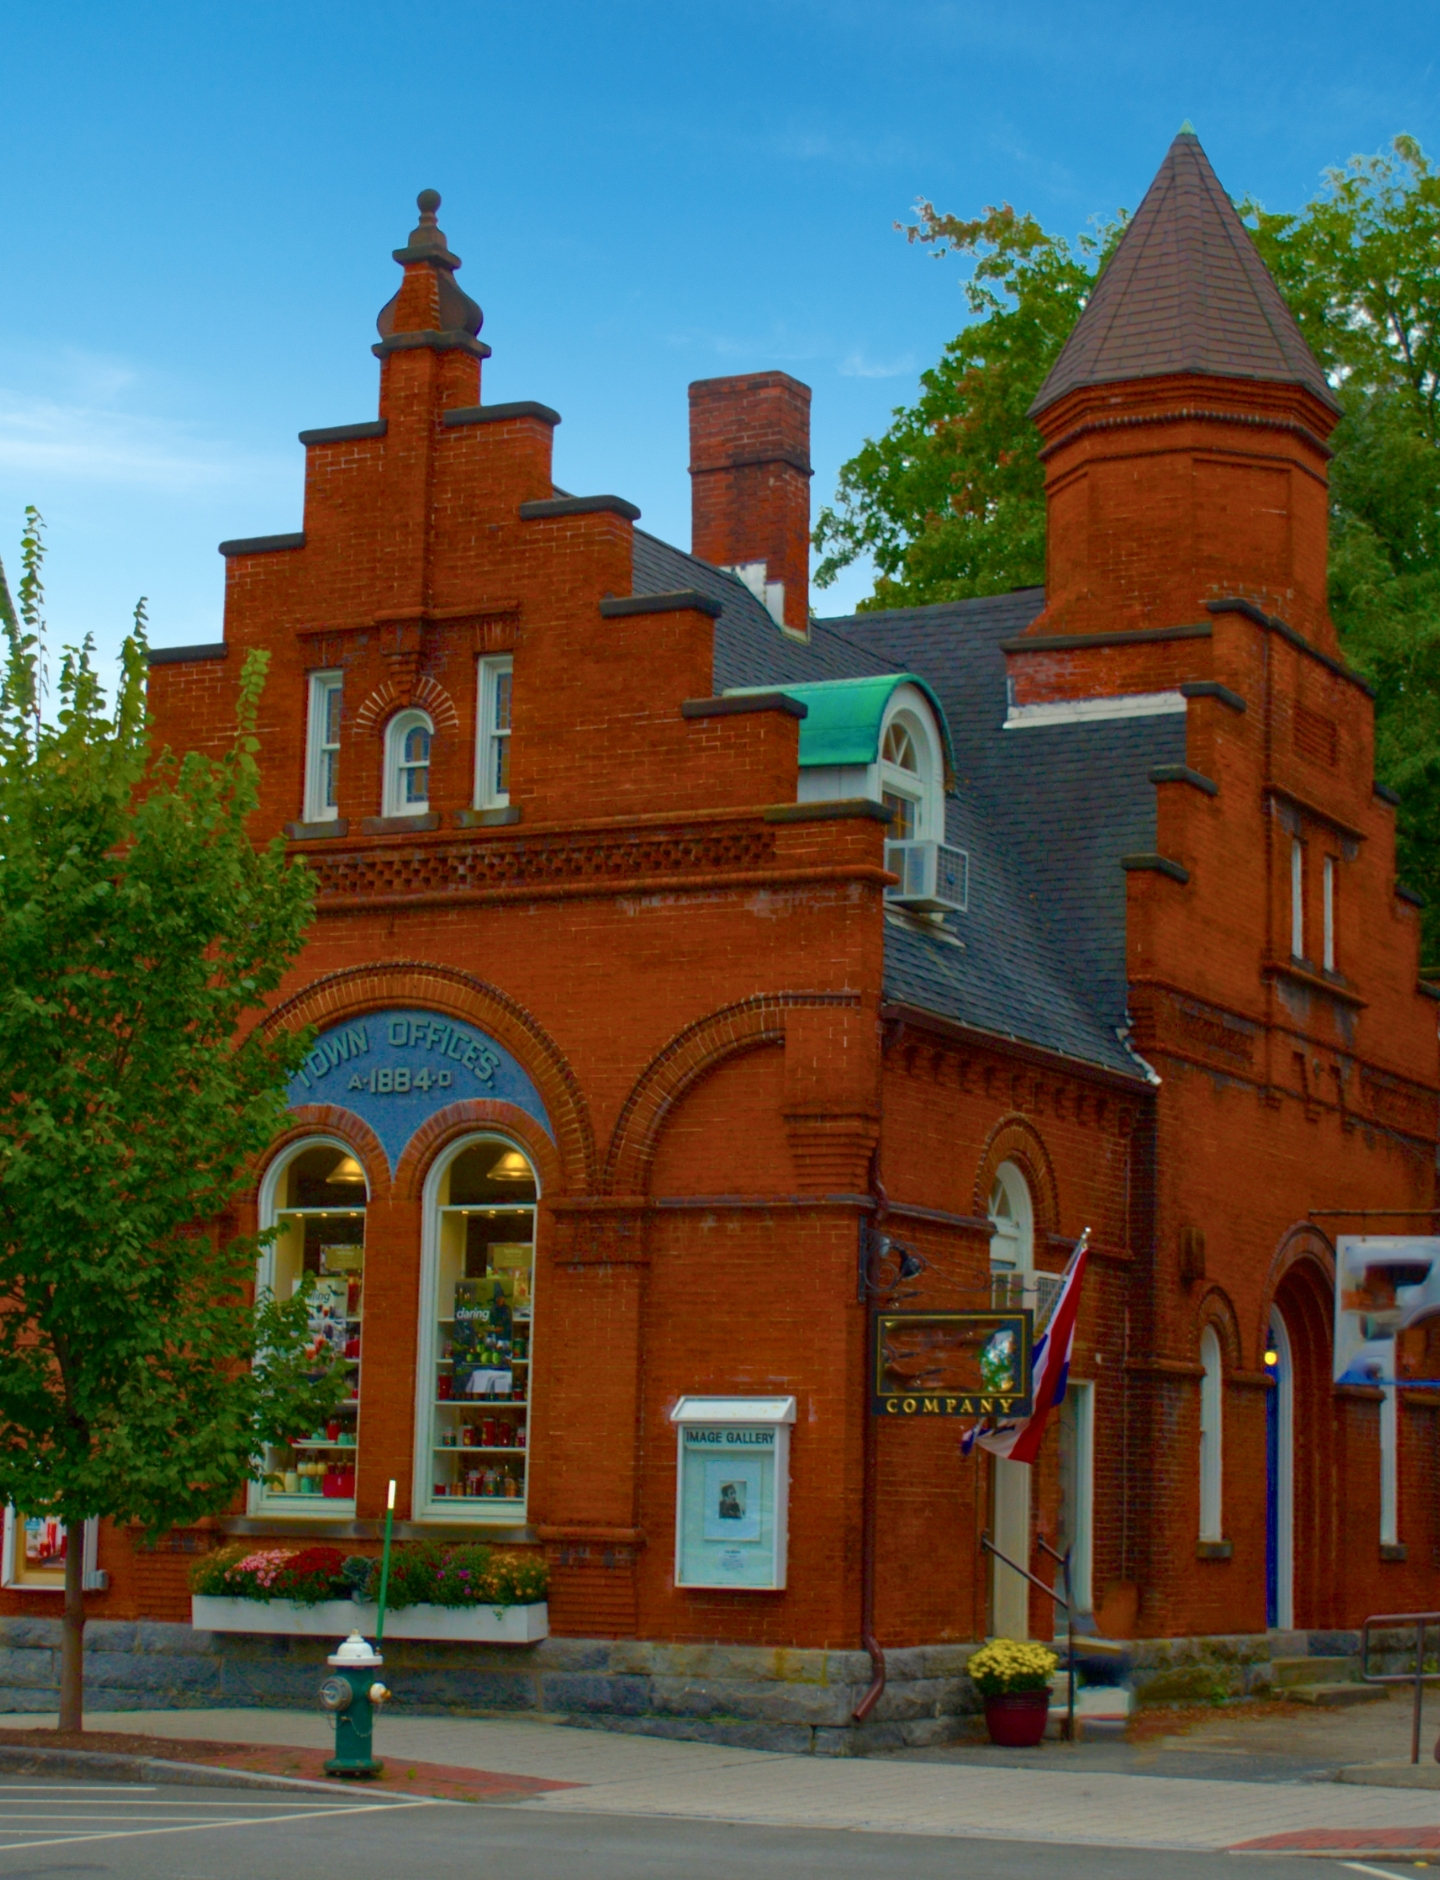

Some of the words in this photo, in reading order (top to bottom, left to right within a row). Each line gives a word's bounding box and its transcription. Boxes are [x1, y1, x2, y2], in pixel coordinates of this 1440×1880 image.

[289, 1024, 368, 1088] TOWN
[456, 1307, 490, 1321] daring
[885, 1398, 1014, 1414] COMPANY
[686, 1431, 722, 1443] IMAGE
[726, 1432, 775, 1444] GALLERY
